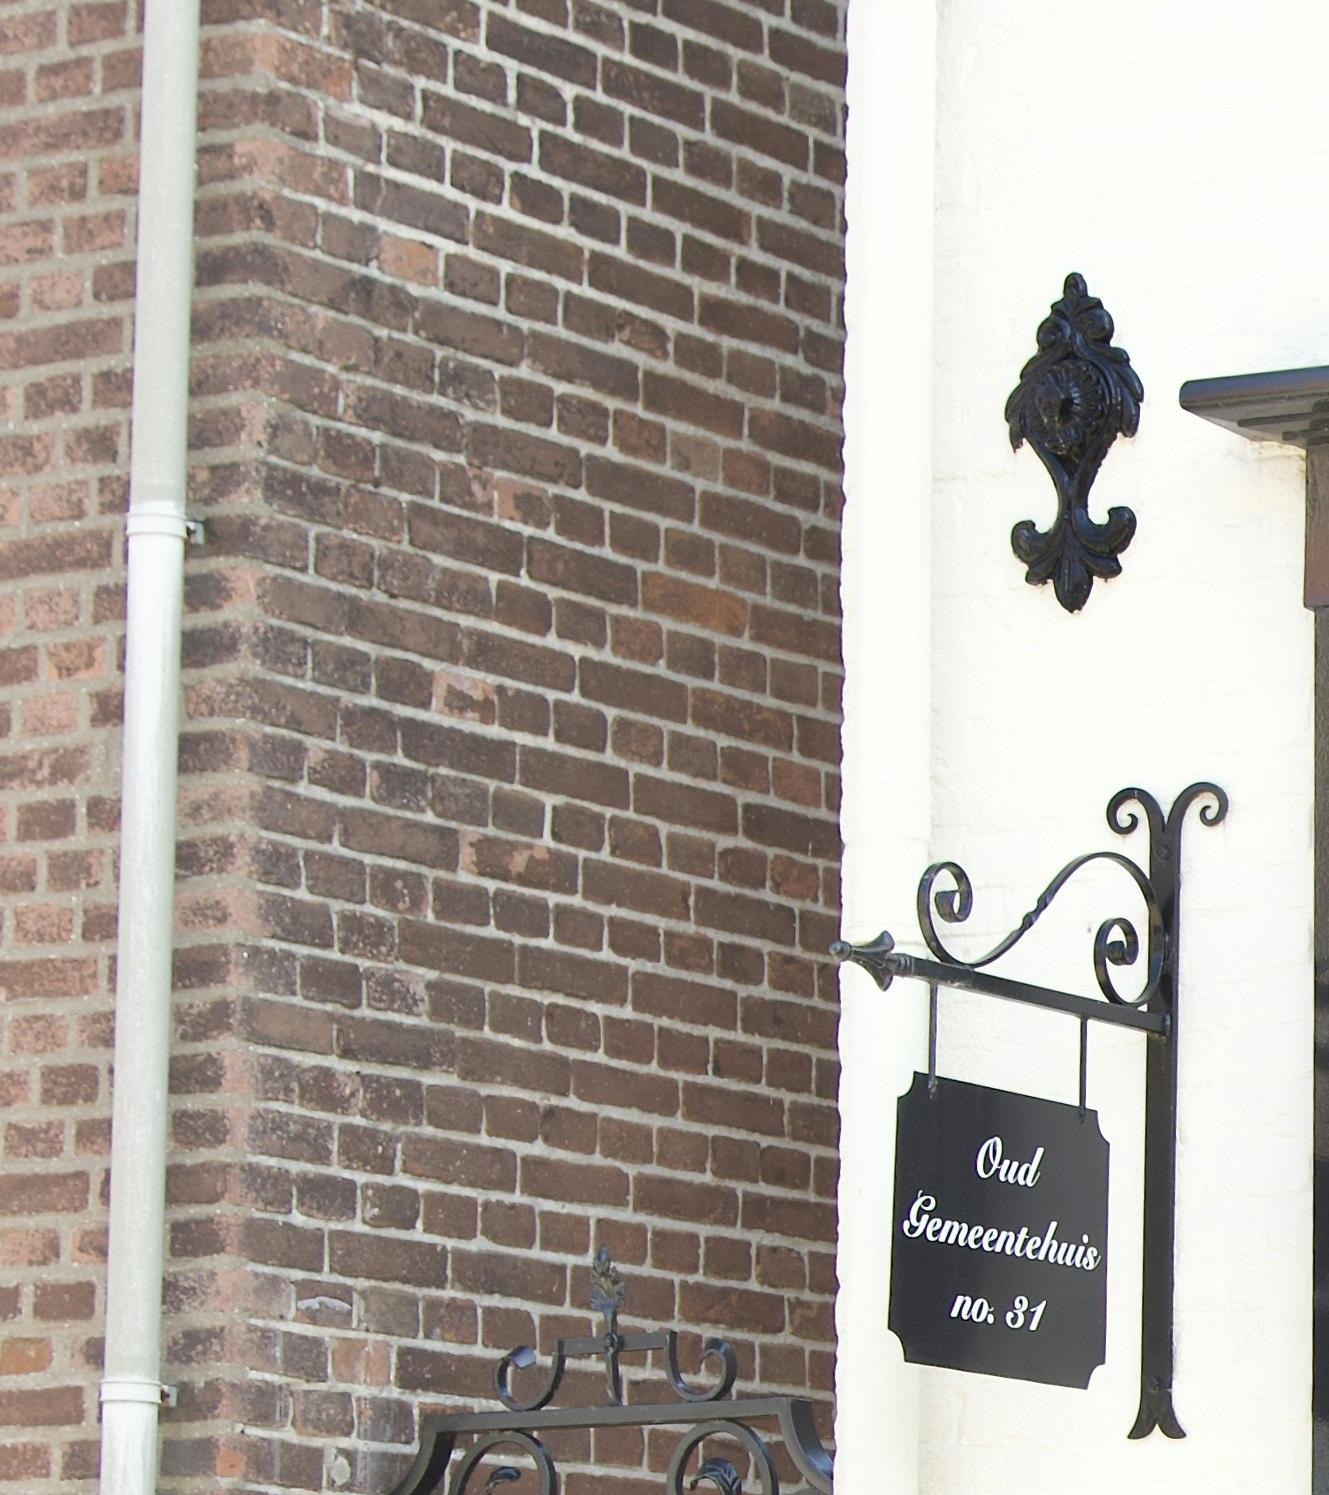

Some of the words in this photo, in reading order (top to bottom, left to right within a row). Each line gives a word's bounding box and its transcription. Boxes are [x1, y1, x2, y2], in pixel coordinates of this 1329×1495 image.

[976, 1136, 1045, 1188] Oud
[902, 1190, 1101, 1271] Gemeentehuis
[950, 1294, 995, 1324] no.
[1005, 1295, 1047, 1331] 31
